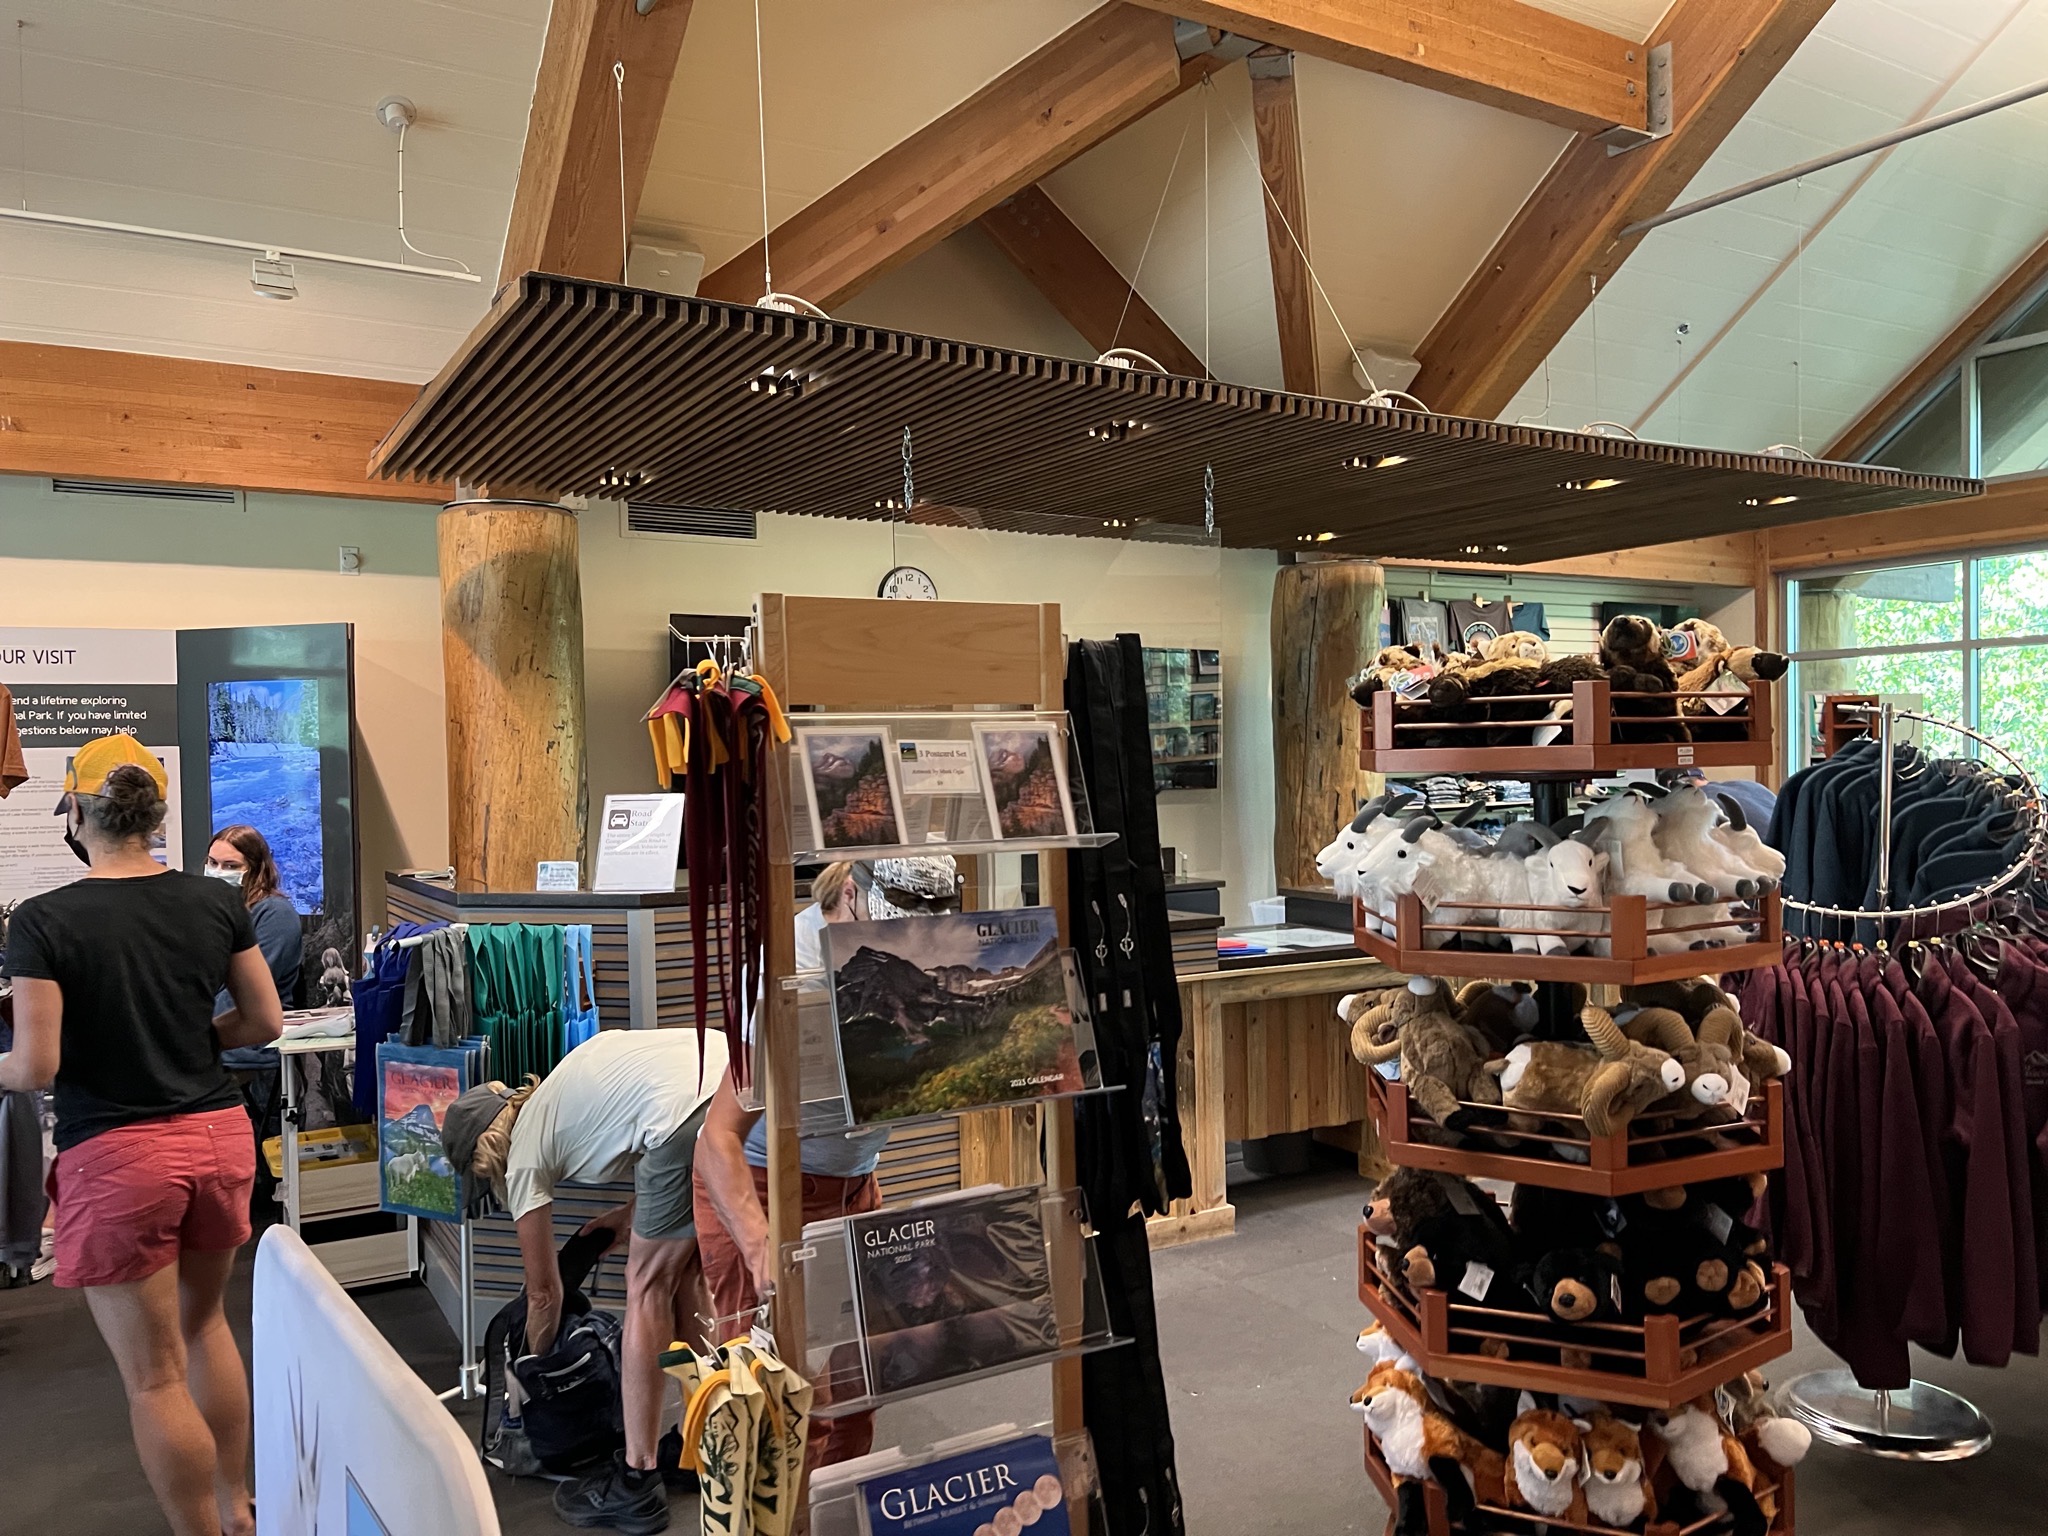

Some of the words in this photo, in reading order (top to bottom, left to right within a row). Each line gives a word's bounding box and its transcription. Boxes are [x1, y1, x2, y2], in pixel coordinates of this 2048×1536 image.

[896, 577, 903, 585] 11
[905, 573, 914, 582] 12
[889, 585, 899, 593] 10
[922, 585, 929, 593] 2
[0, 649, 26, 664] UR
[33, 649, 77, 664] VISIT
[12, 696, 30, 706] end
[41, 696, 78, 705] lifetime
[81, 696, 127, 707] exploring
[13, 710, 26, 720] nal
[29, 710, 54, 720] Park.
[57, 711, 65, 720] If
[68, 712, 87, 722] you
[88, 710, 112, 720] have
[114, 710, 147, 720] limited
[17, 726, 57, 737] gestions
[60, 726, 89, 735] below
[92, 728, 113, 737] may
[115, 725, 139, 737] help.
[925, 750, 955, 758] Postcard
[956, 750, 967, 758] Set
[631, 810, 653, 818] Road
[630, 820, 649, 828] Stat
[976, 919, 1040, 937] GLACIER
[391, 1071, 453, 1090] GLACIER
[1027, 1073, 1065, 1085] CALENDAR
[864, 1220, 935, 1247] GLACIER
[867, 1243, 914, 1259] NATIONAL
[914, 1238, 937, 1250] PARK
[880, 1463, 1019, 1520] GLACIER
